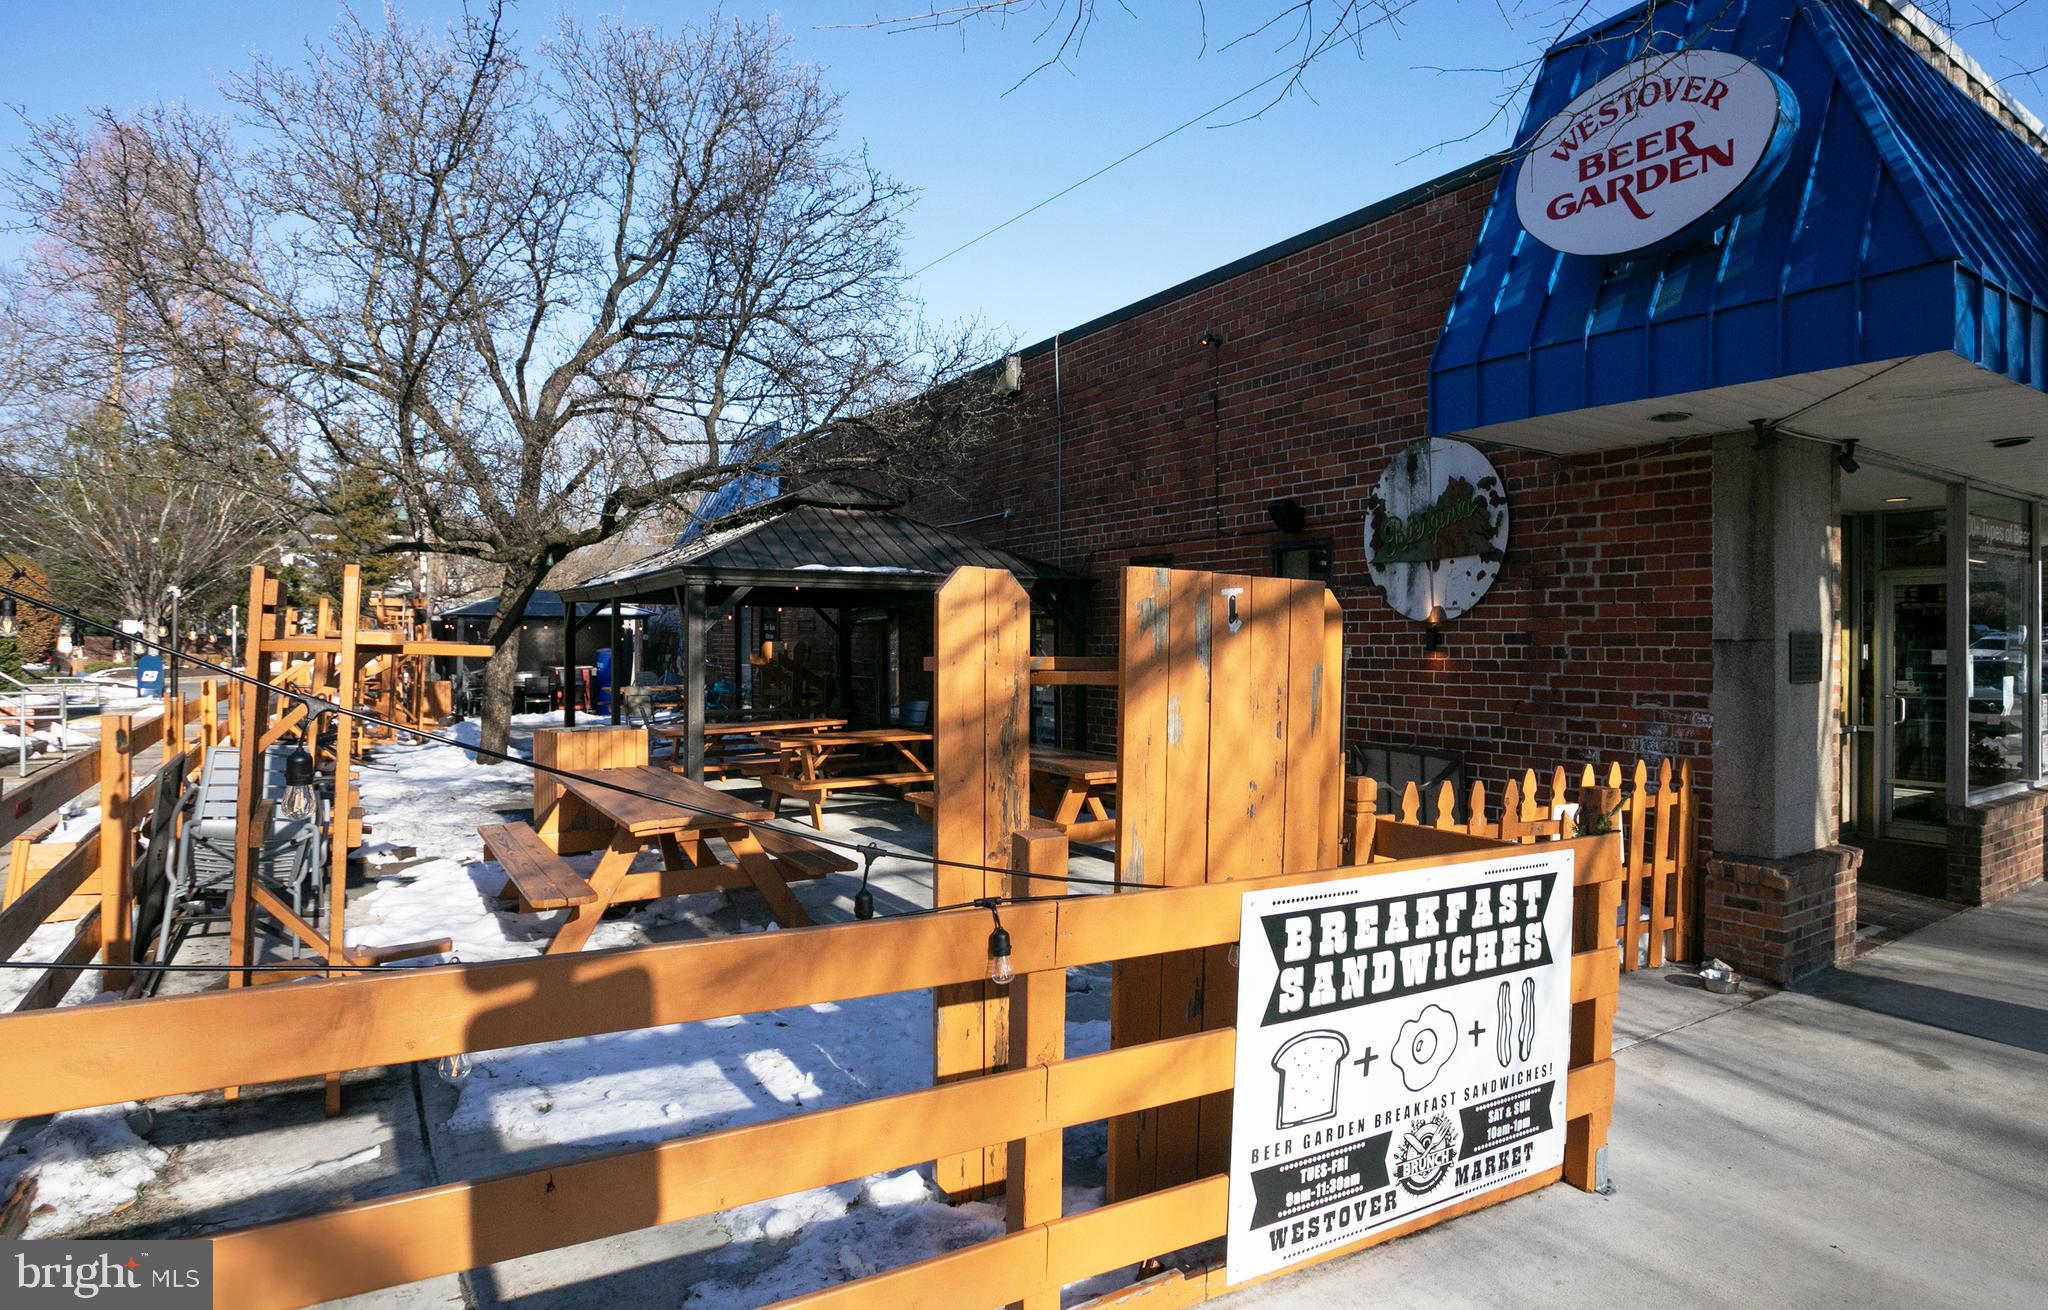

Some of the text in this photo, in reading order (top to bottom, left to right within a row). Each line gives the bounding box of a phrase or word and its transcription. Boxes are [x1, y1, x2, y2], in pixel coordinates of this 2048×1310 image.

[1550, 75, 1729, 164] WESTOVER
[1578, 120, 1704, 183] BEER
[1546, 138, 1735, 220] GARDEN
[1283, 880, 1543, 963] BREAKFAST
[1278, 921, 1544, 1014] SANDWICHES
[1251, 1062, 1554, 1164] BEER GARDEN BREAKFAST SANDWICHES!
[1486, 1116, 1531, 1141] 10am-1pm
[1488, 1098, 1531, 1123] SAT & SUN
[1269, 1141, 1534, 1251] WESTOVER MARKET
[1285, 1172, 1361, 1208] 9am-11:30am
[1300, 1156, 1349, 1184] TUES-FRI
[1402, 1150, 1450, 1176] BRUNCH
